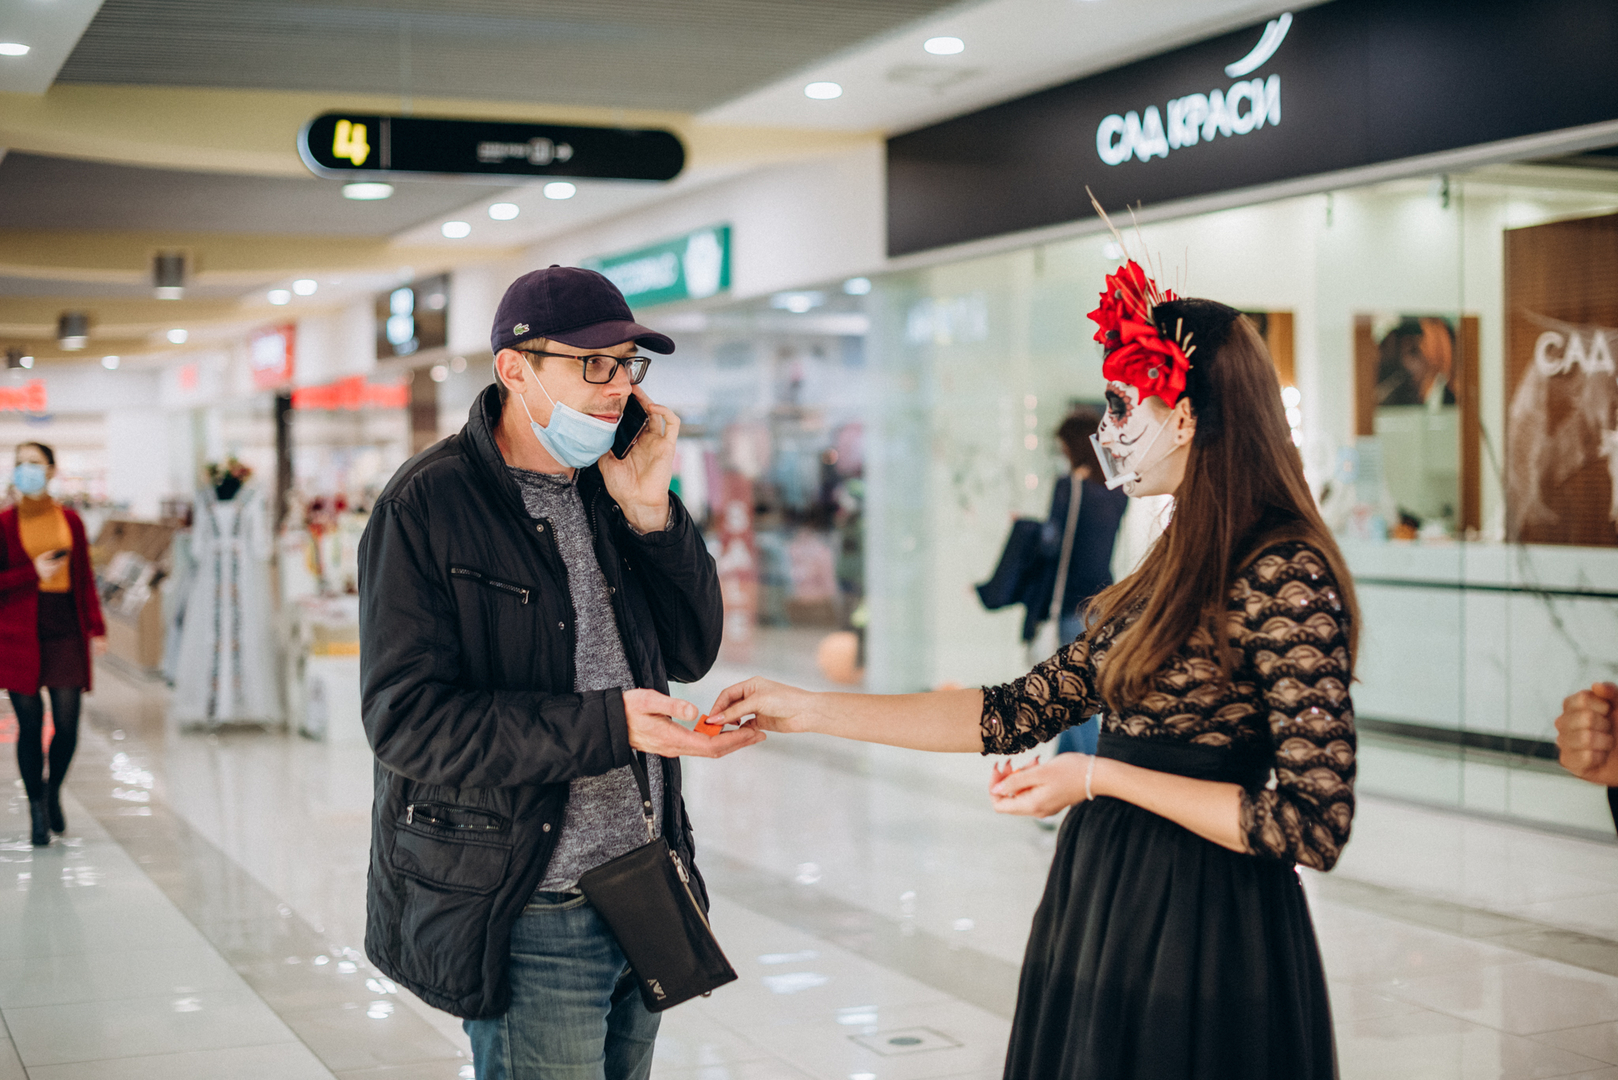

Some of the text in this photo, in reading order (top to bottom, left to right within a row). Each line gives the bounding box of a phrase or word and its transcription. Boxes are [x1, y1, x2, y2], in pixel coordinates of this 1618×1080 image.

[333, 119, 370, 167] 4
[1096, 74, 1281, 166] САД КРАСИ
[1534, 330, 1616, 377] САД
